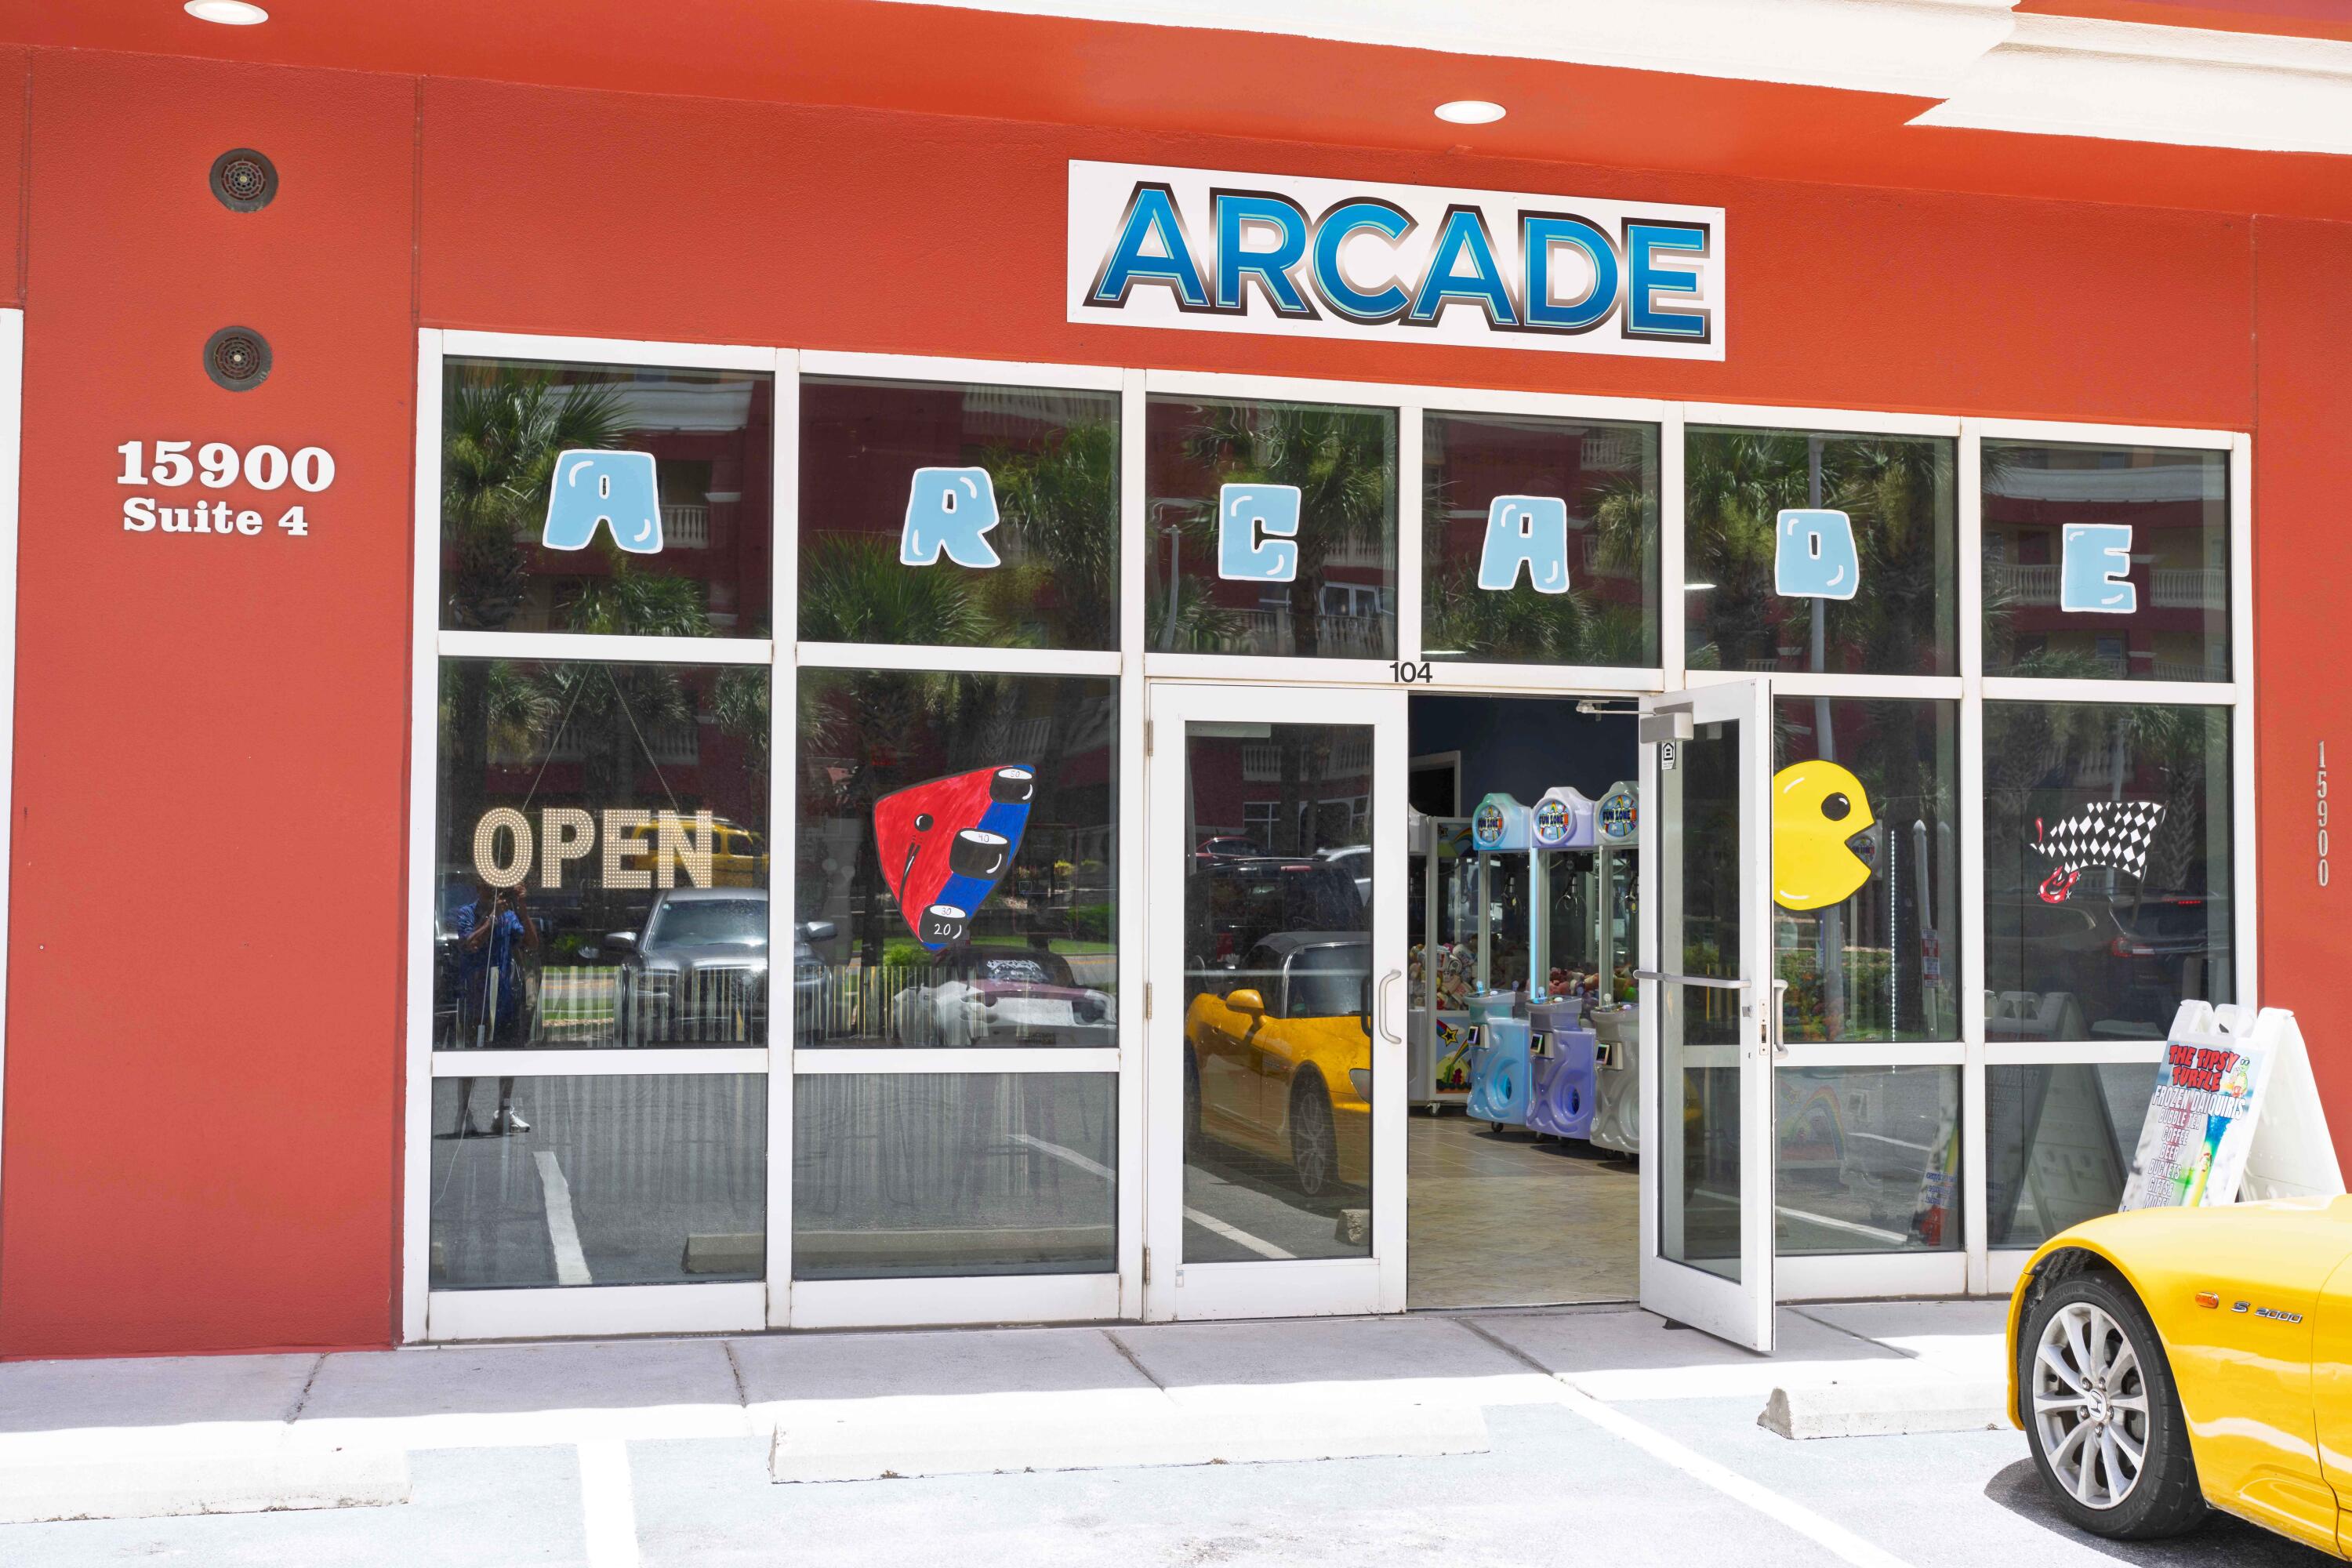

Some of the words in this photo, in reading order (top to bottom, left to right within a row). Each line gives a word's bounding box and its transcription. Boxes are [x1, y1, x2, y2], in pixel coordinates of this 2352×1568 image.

[1083, 180, 1711, 345] ARCADE
[117, 440, 336, 492] 15900
[123, 496, 263, 535] Suite
[278, 506, 308, 535] 4
[1389, 661, 1433, 684] 104
[1010, 770, 1020, 779] 50
[1539, 814, 1550, 825] FUN
[1549, 813, 1563, 825] ZONE
[1602, 809, 1614, 821] FUN
[2317, 739, 2329, 887] 15900
[473, 807, 713, 889] OPEN
[978, 833, 989, 843] 40
[941, 907, 952, 916] 30
[934, 923, 951, 936] 20
[2169, 1044, 2197, 1067] THE
[2197, 1048, 2240, 1073] TIPSY
[2172, 1065, 2223, 1092] TURTLE
[2151, 1085, 2192, 1110] FROZEN
[2190, 1091, 2246, 1120] DAIQUIRIS
[2158, 1108, 2188, 1127] BUBBLE
[2187, 1112, 2201, 1130] TEA
[2161, 1126, 2189, 1145] COFFEE
[2159, 1143, 2180, 1162] BEER
[2148, 1159, 2182, 1180] BUCKETS
[2230, 1301, 2251, 1312] S
[2255, 1307, 2303, 1323] 2000
